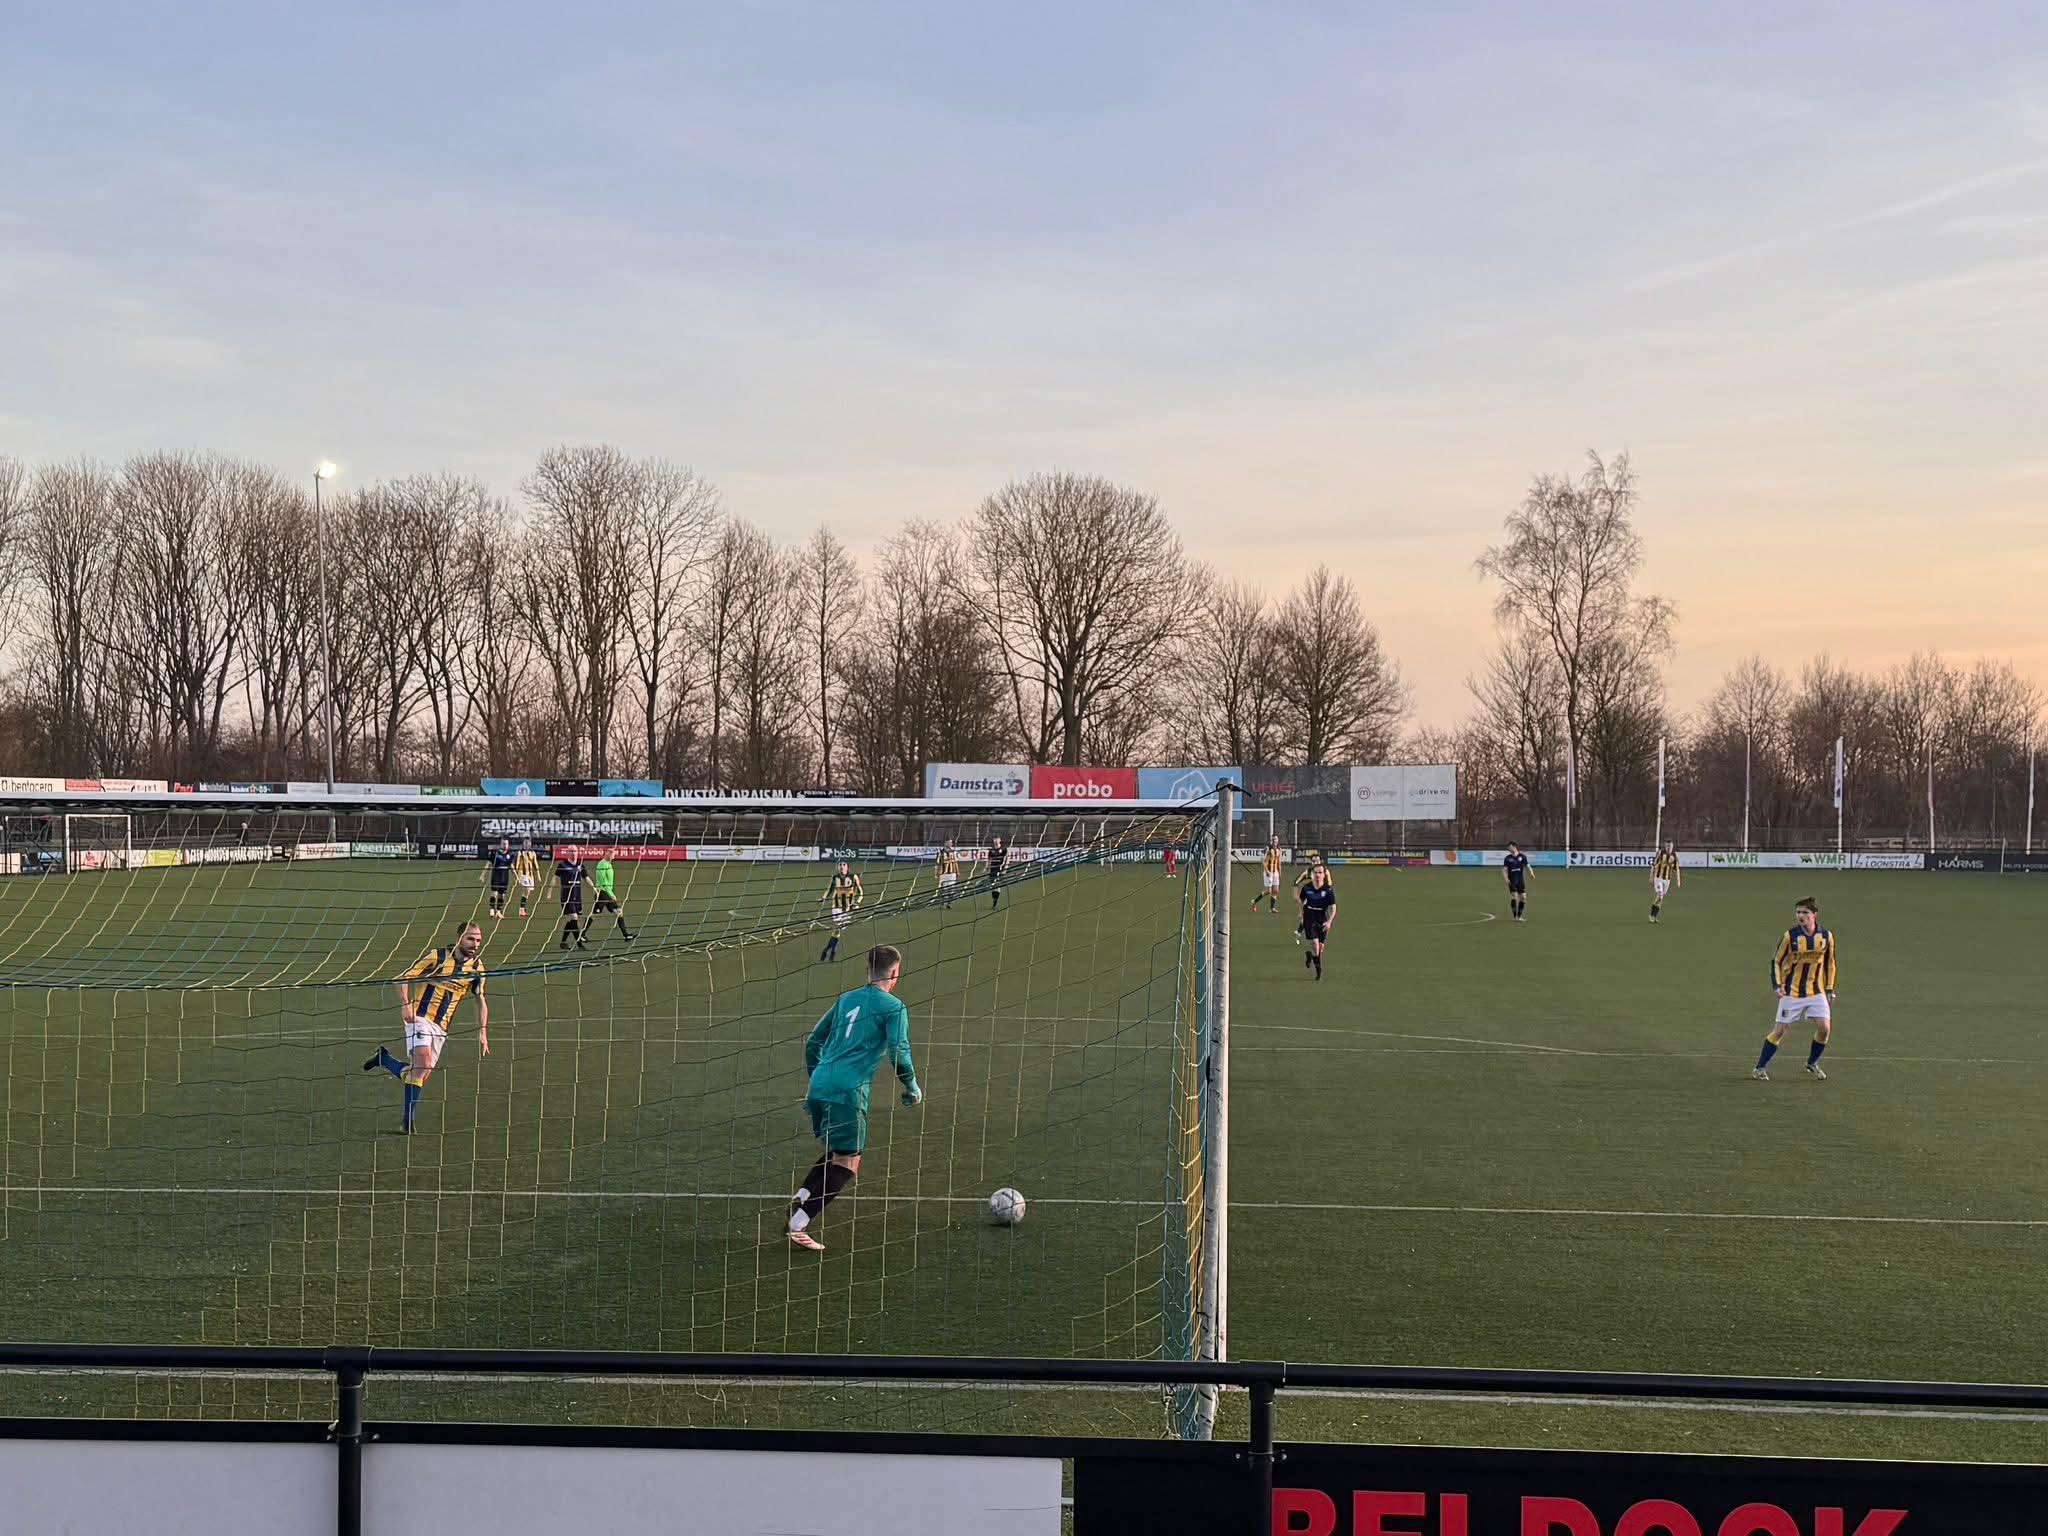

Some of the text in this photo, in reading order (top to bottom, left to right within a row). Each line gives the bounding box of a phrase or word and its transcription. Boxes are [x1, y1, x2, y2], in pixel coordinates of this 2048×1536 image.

[939, 777, 1004, 791] Damstra
[1053, 780, 1113, 799] probo
[491, 820, 657, 834] Albert Heijn Dokkum
[833, 849, 857, 858] bc3s
[1727, 854, 1758, 864] WMR
[1815, 853, 1847, 865] WMR
[845, 1006, 861, 1038] 1
